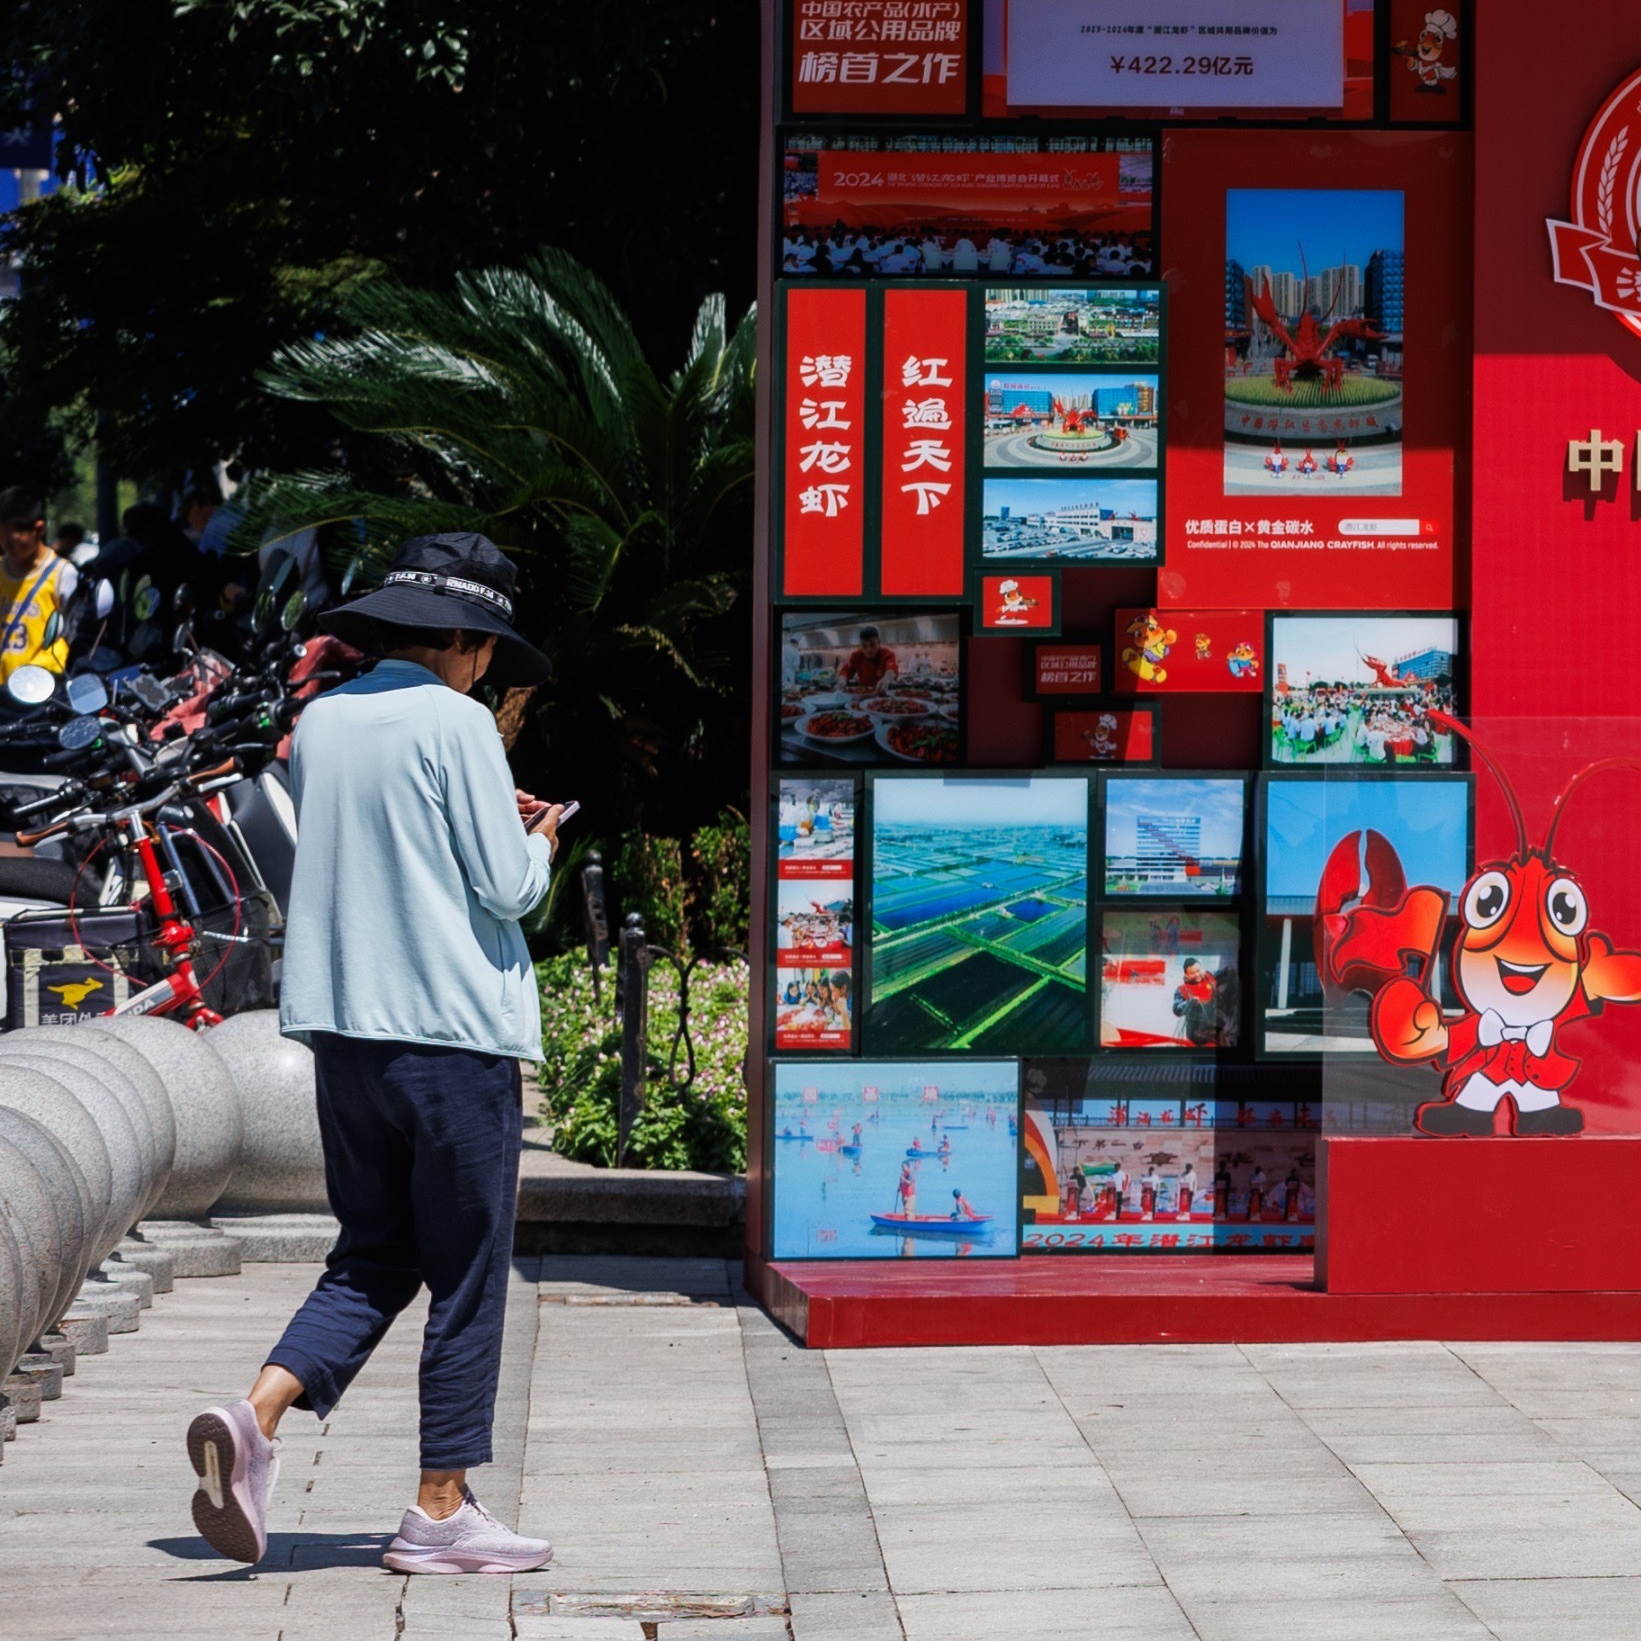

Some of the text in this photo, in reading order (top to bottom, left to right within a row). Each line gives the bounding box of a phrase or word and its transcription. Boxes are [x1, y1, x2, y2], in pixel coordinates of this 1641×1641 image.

[801, 1, 960, 19] 中国农产品(水产)
[800, 19, 961, 41] 区域公用品牌
[799, 51, 961, 84] 榜首之作
[1110, 56, 1254, 76] ¥422.29亿元
[834, 172, 885, 188] 2024
[799, 354, 852, 517] 潜江龙虾
[901, 355, 952, 515] 红遍天下
[1185, 519, 1314, 535] 优质蛋白×黄金碳水
[1270, 541, 1325, 549] QIANJIANG
[42, 1011, 107, 1026] 美团外
